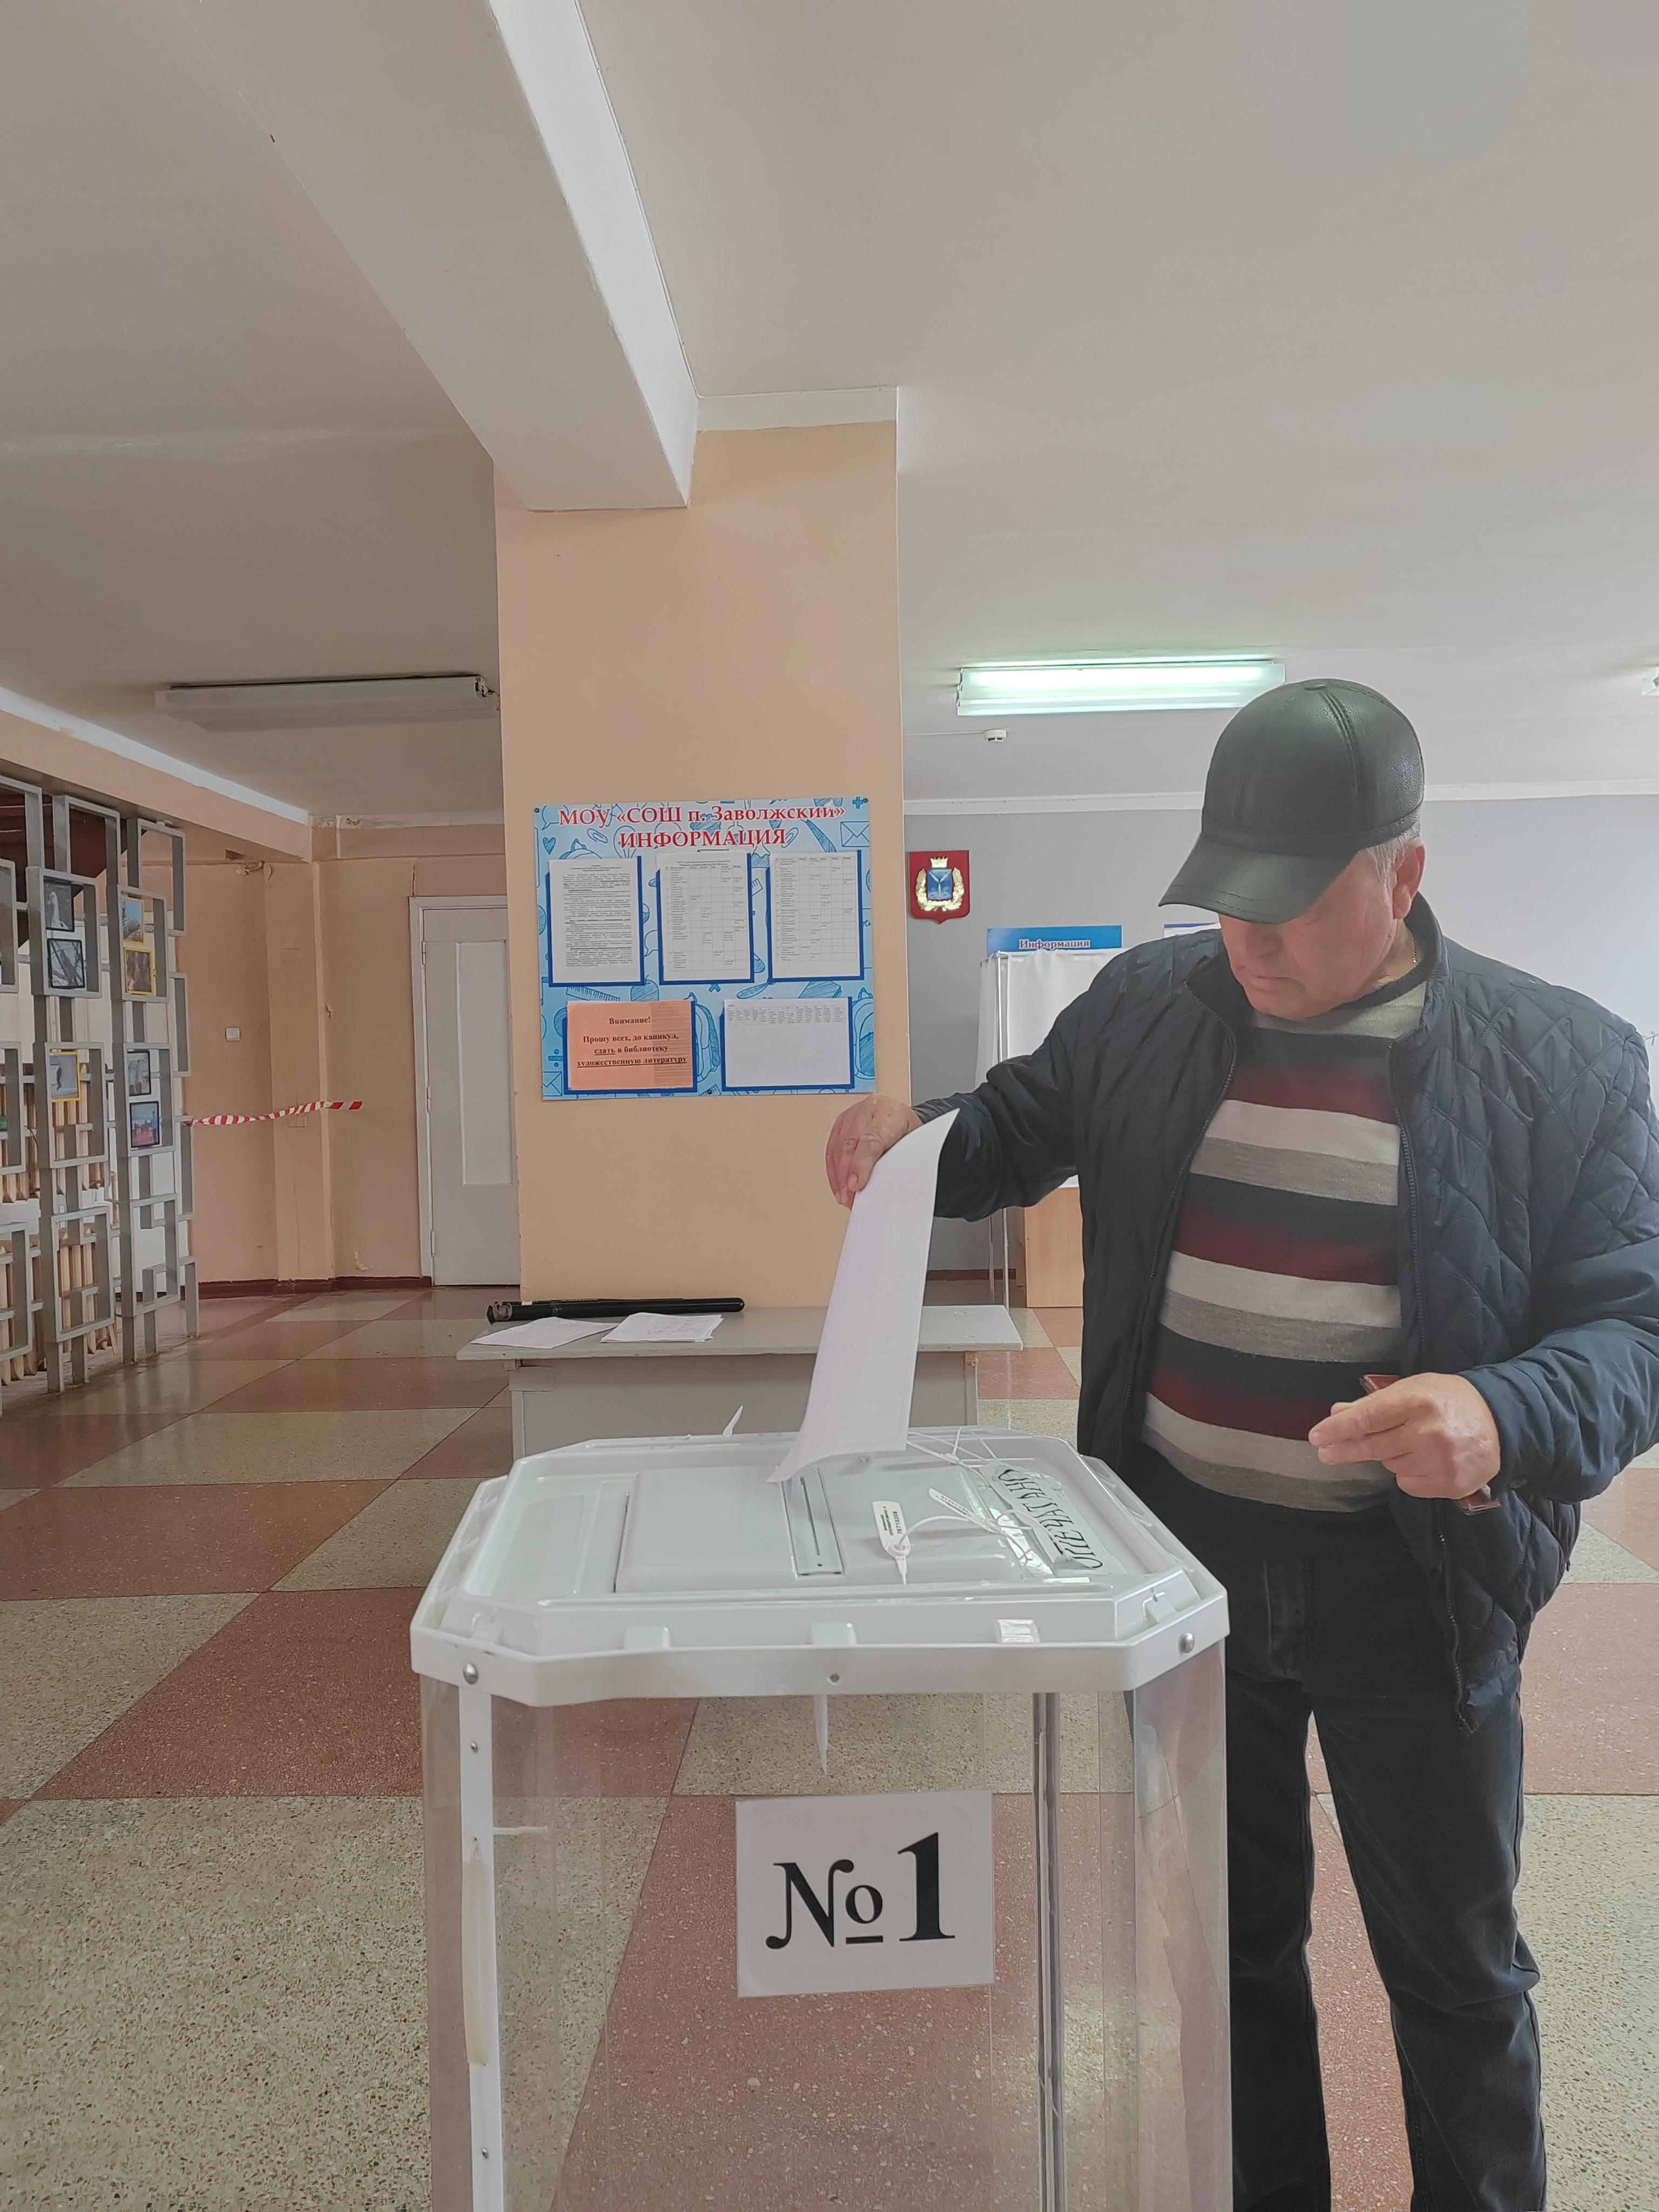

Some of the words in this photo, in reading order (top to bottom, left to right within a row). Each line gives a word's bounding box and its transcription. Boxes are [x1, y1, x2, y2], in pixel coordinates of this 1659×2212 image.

[559, 808, 611, 828] МОУ
[617, 807, 682, 824] «СОШ
[688, 811, 705, 822] п.
[619, 828, 787, 848] ИНФОРМАЦИЯ
[1020, 939, 1090, 950] Информация
[609, 1016, 651, 1025] Внимание!
[583, 1035, 610, 1044] Прошу
[644, 1033, 679, 1041] каникул,
[624, 1045, 669, 1053] библиотеку
[577, 1057, 641, 1068] художественную
[643, 1056, 687, 1065] литературу
